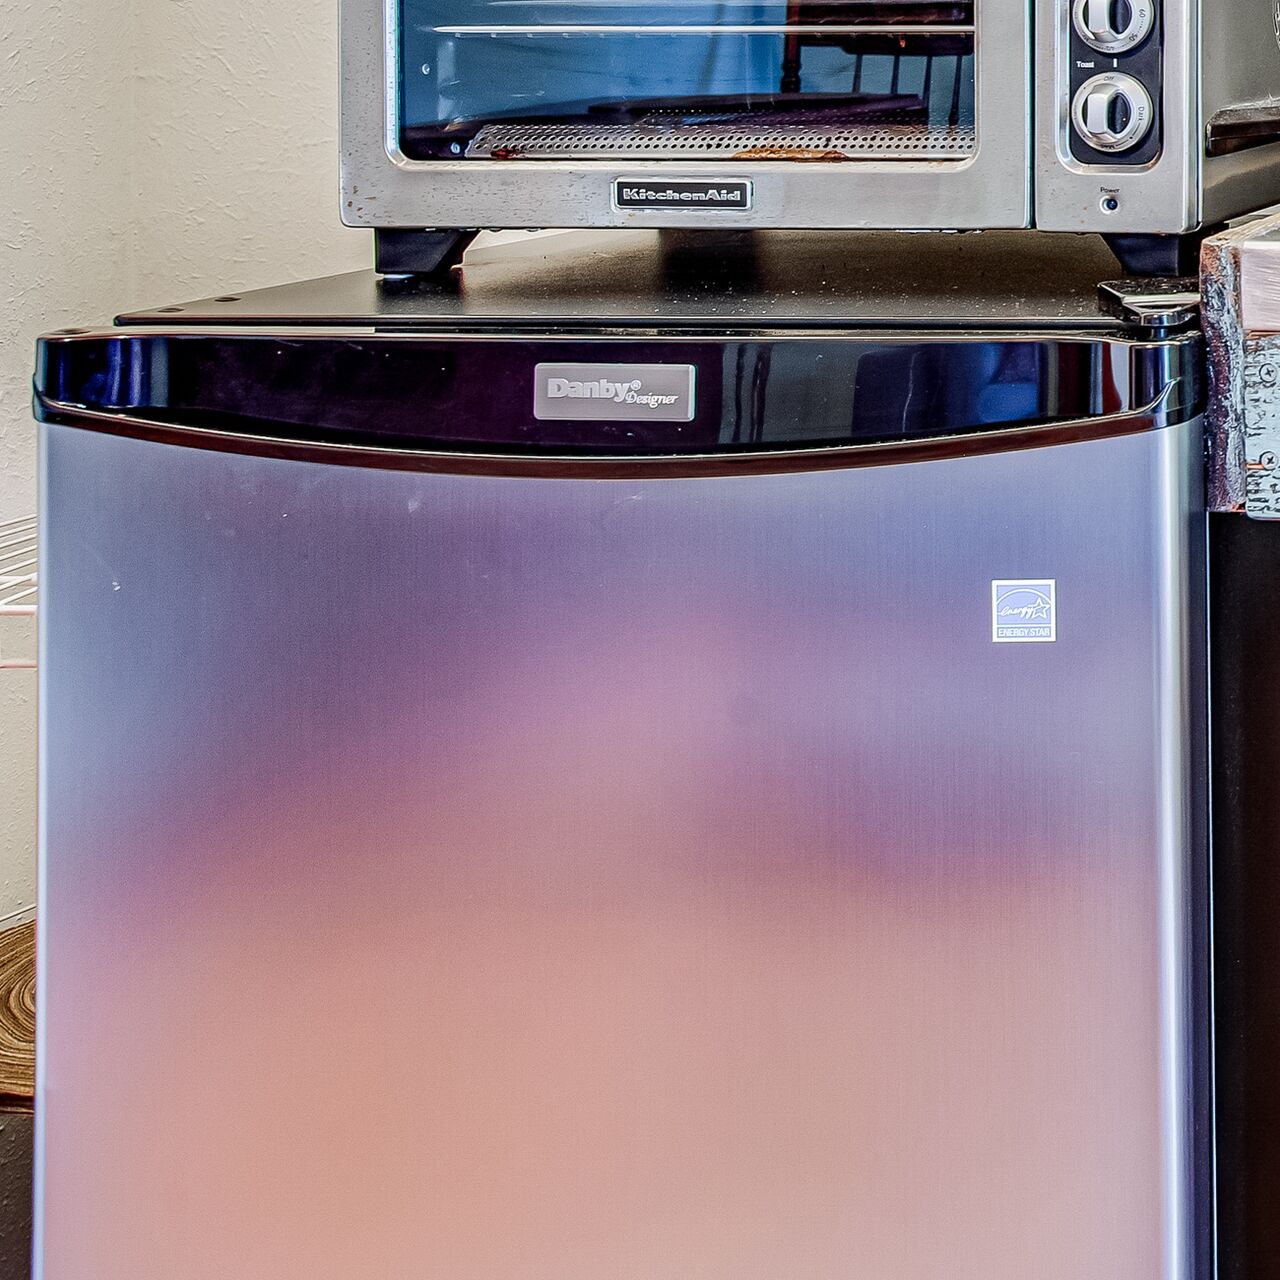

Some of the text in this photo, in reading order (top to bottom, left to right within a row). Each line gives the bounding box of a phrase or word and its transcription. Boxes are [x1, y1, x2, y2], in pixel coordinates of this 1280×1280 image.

[623, 189, 741, 200] KitchenAid
[547, 378, 678, 408] Danby Designer
[999, 628, 1050, 637] ENERGY STAR
